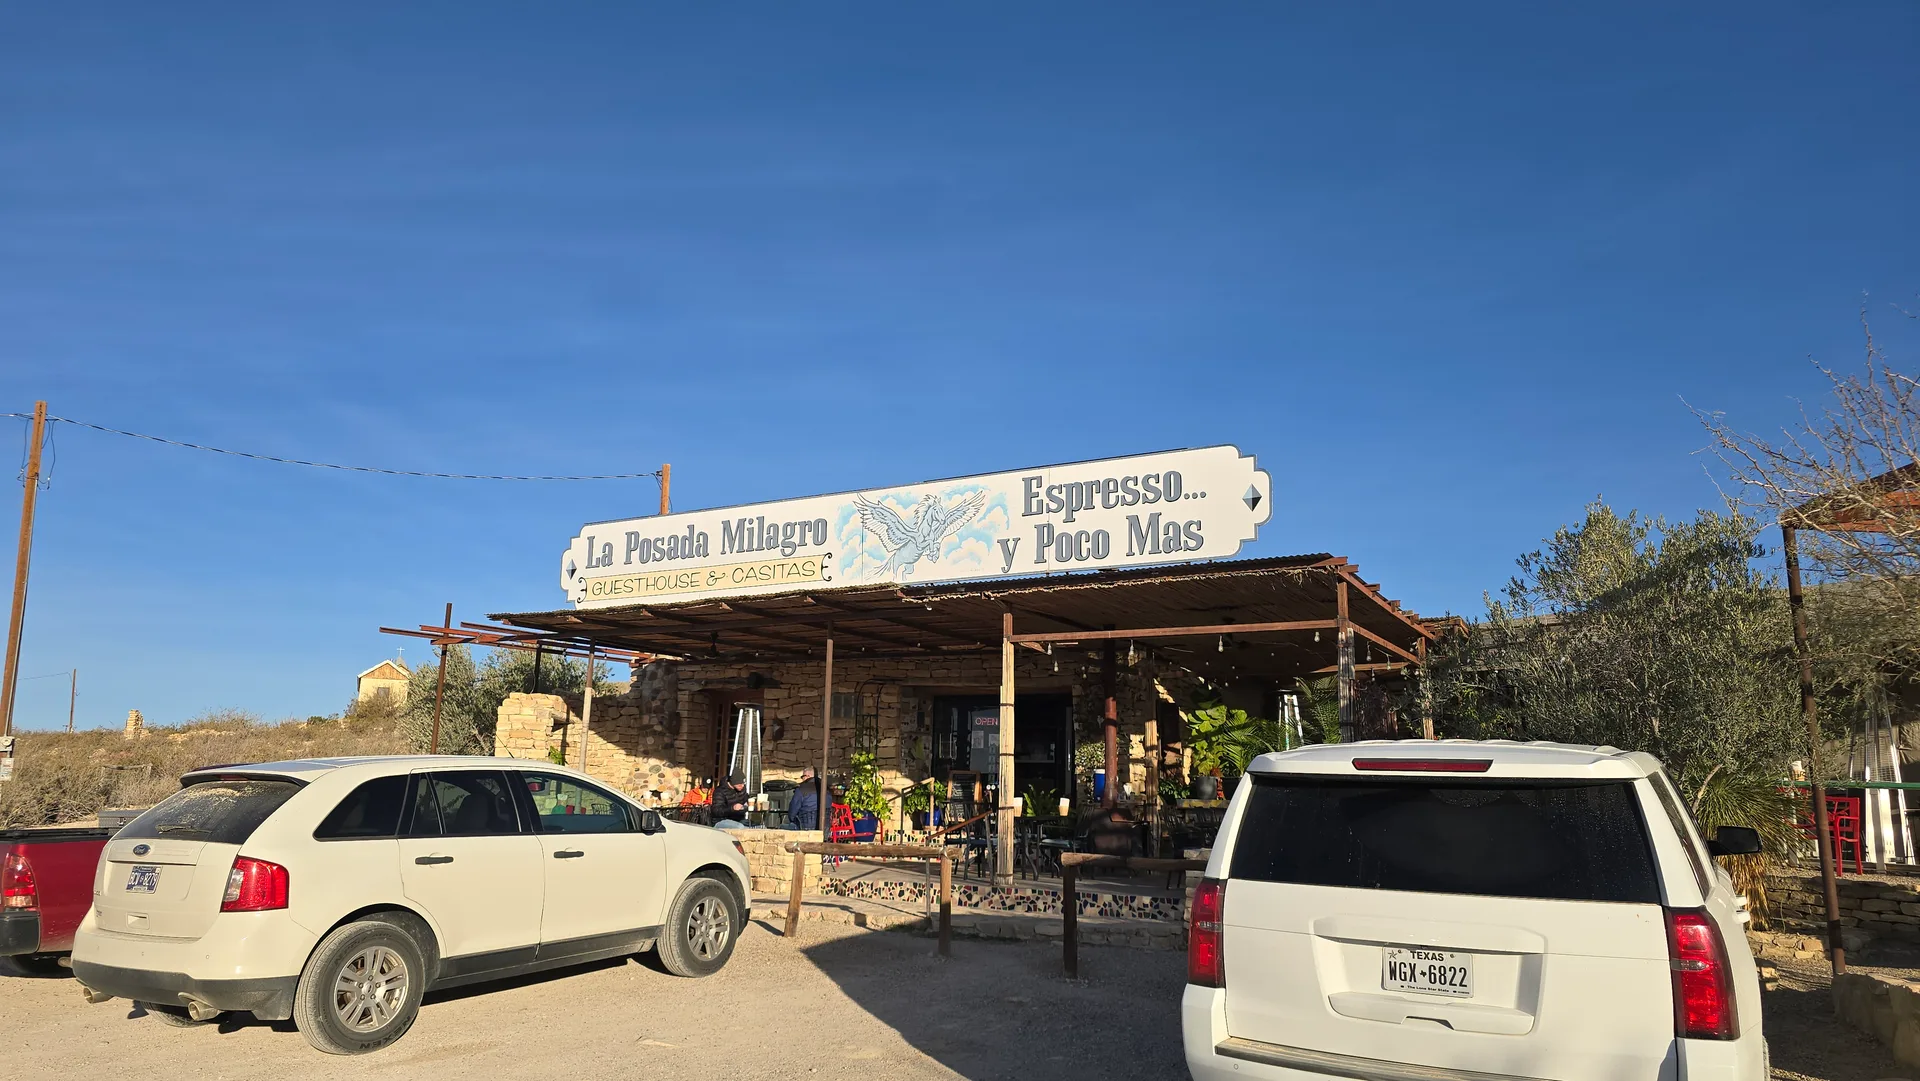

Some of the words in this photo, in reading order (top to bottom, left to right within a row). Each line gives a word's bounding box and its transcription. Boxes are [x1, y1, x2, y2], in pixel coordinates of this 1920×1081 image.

[1021, 470, 1207, 523] Espresso...
[585, 535, 614, 569] La
[623, 524, 710, 565] Posada
[720, 516, 828, 557] Milagro
[997, 537, 1021, 573] y
[1034, 521, 1110, 565] Poco
[1125, 512, 1204, 557] Mas
[592, 572, 701, 596] GUESTHOUSE
[706, 570, 726, 587] &
[732, 561, 816, 584] CASITAS
[975, 717, 998, 726] OPEN
[1410, 951, 1444, 961] TEXAS
[1389, 960, 1417, 983] WGX
[1428, 964, 1468, 988] 6822
